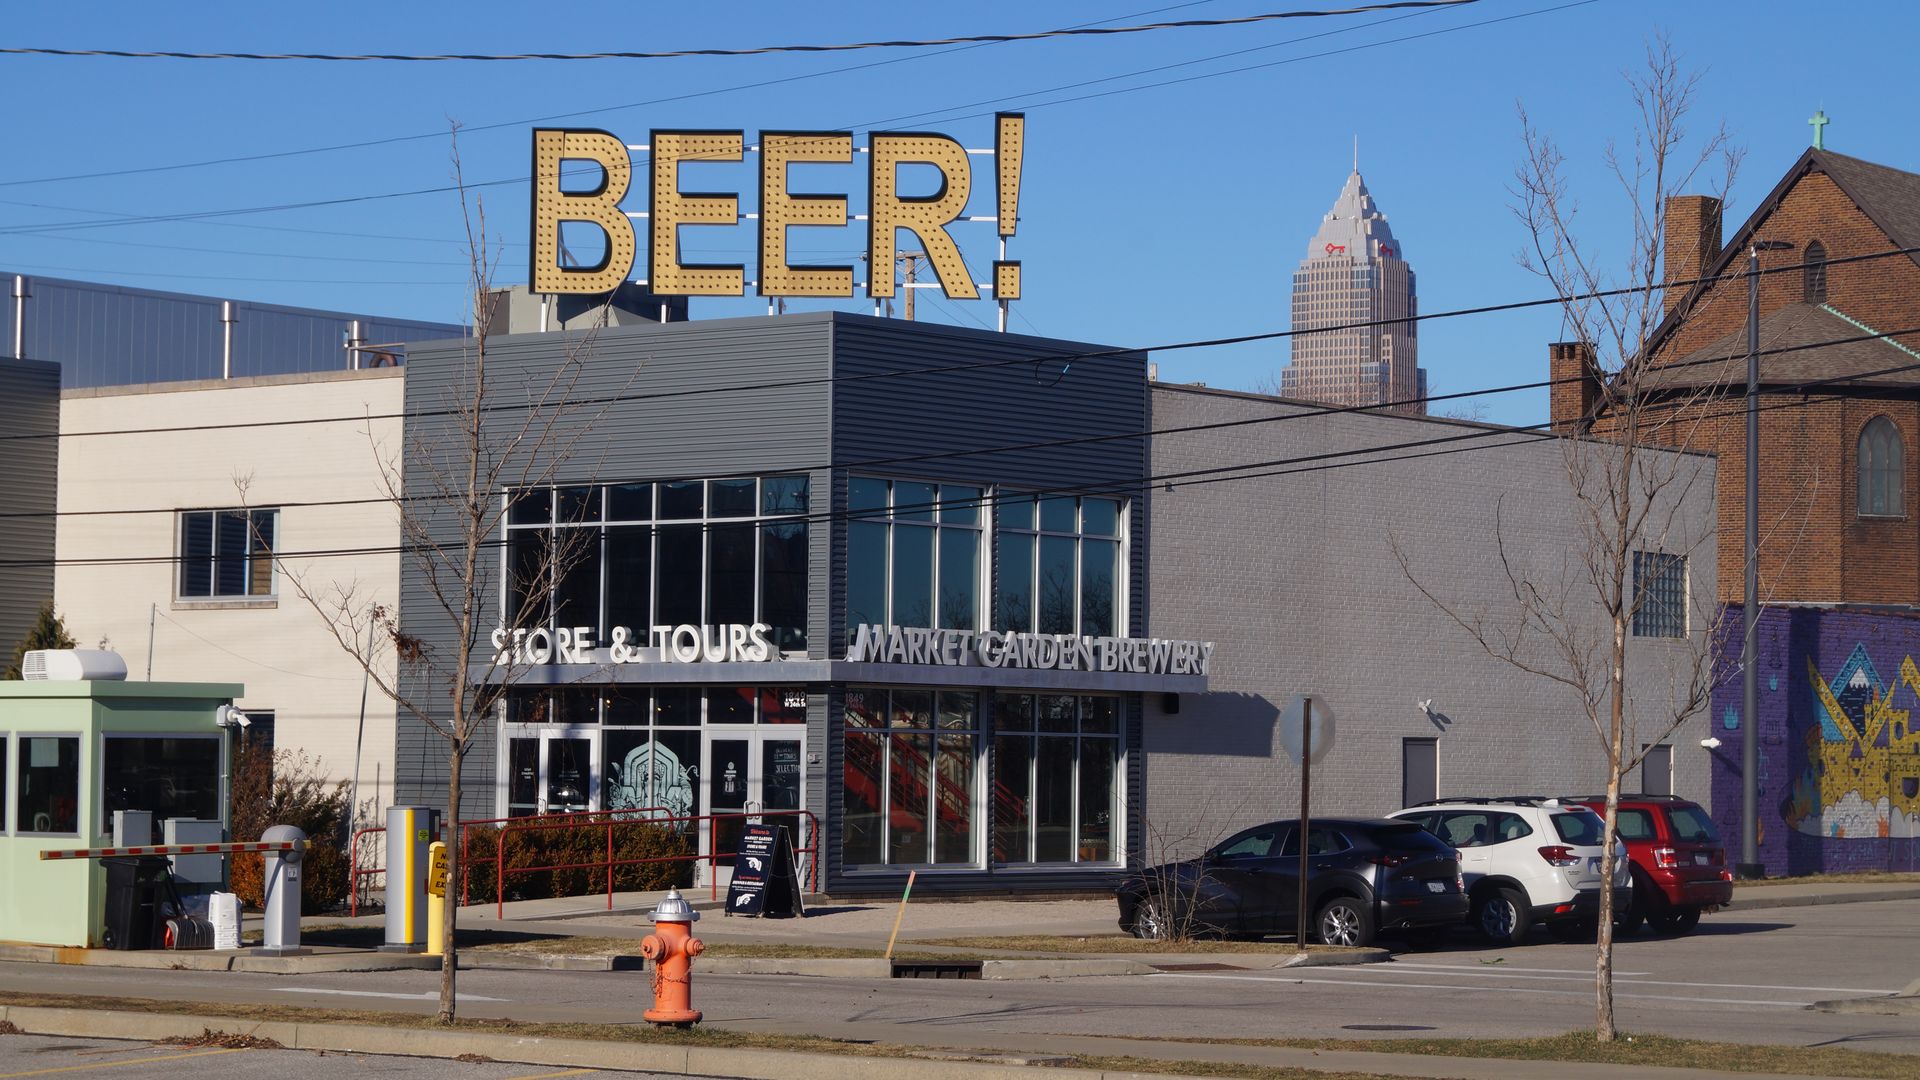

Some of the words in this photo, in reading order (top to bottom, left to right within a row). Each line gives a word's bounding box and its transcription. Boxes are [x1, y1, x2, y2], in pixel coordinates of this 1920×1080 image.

[529, 112, 1025, 300] BEER!
[491, 625, 595, 665] STORE
[609, 625, 640, 664] &
[653, 623, 771, 664] TOURS
[854, 623, 973, 666] MARKET
[978, 630, 1094, 671] GARDEN
[1099, 636, 1216, 676] BREWERY
